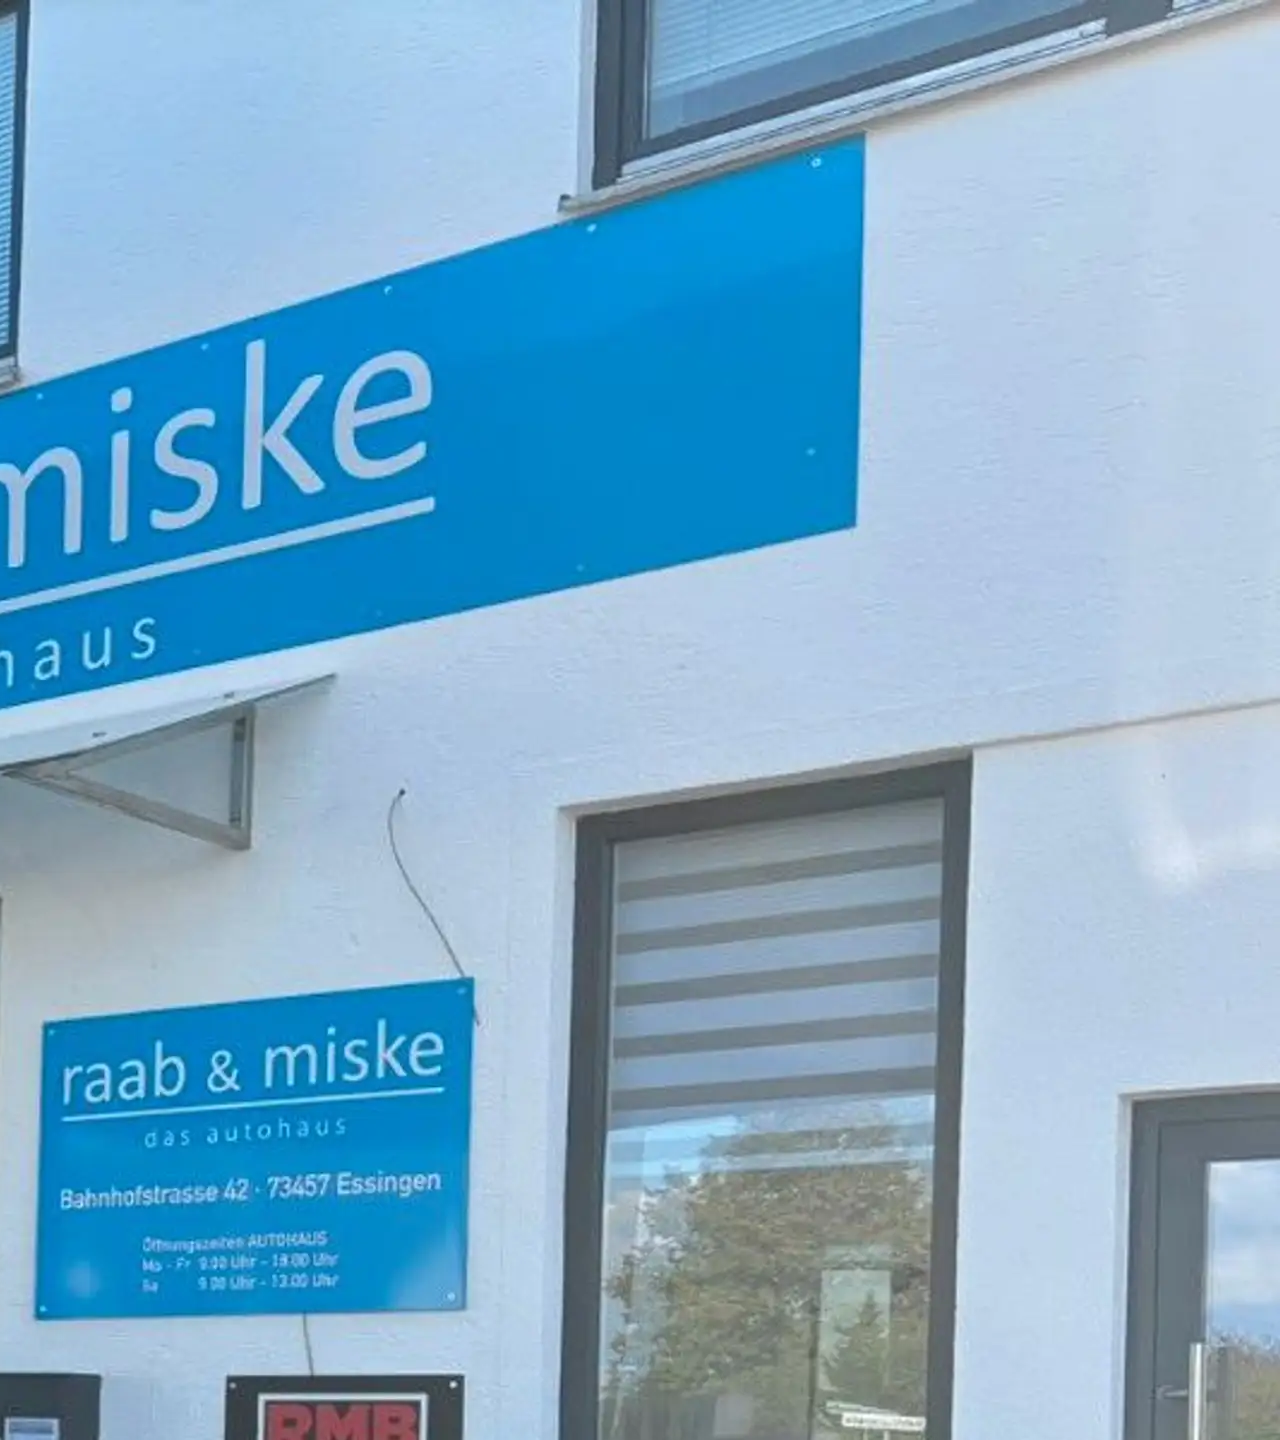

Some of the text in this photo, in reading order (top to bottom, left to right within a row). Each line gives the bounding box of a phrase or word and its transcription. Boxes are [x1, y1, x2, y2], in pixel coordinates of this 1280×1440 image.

[63, 1018, 445, 1106] raab & miske
[144, 1117, 348, 1149] das autohaus
[59, 1181, 219, 1211] Bahnhofstrasse
[224, 1178, 249, 1202] 42
[267, 1173, 330, 1201] 73457
[336, 1170, 441, 1199] Essingen
